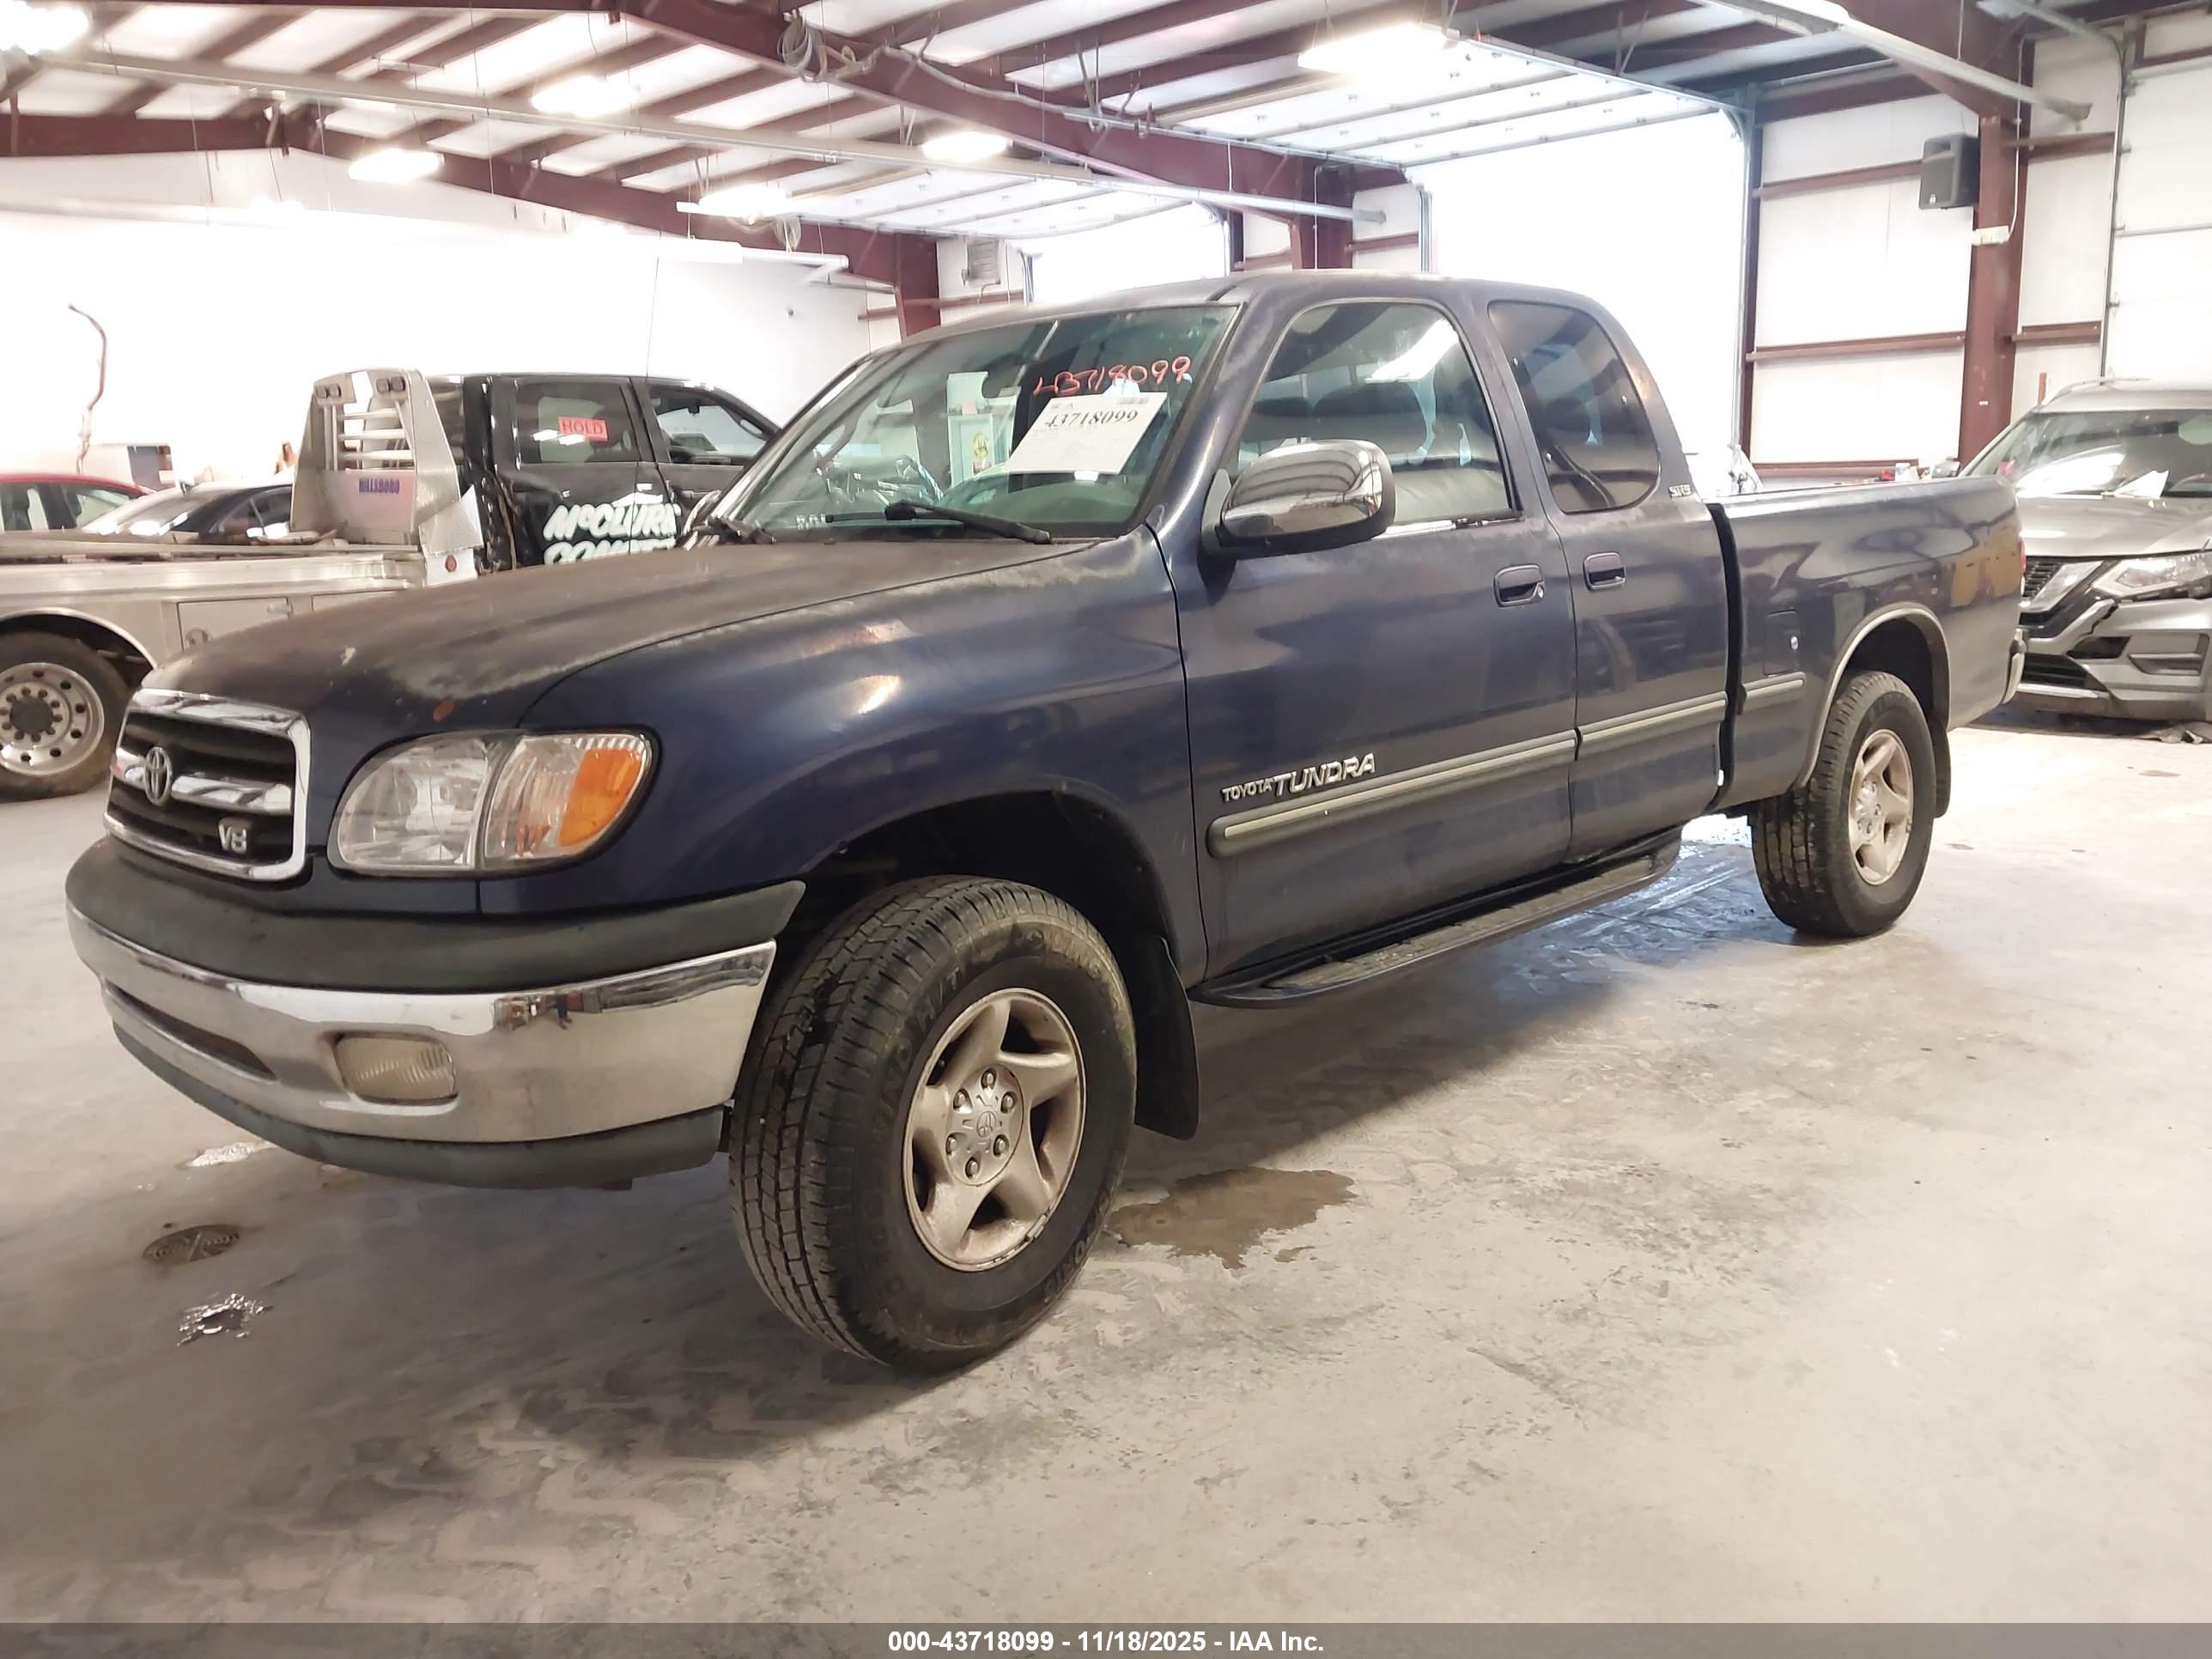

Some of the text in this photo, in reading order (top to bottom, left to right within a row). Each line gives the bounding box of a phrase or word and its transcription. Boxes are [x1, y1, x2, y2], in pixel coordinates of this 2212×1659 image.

[562, 419, 604, 434] HOLD
[1044, 409, 1139, 428] 43718099
[1221, 752, 1376, 802] TOYOTA TUNDRA
[217, 823, 247, 854] V8
